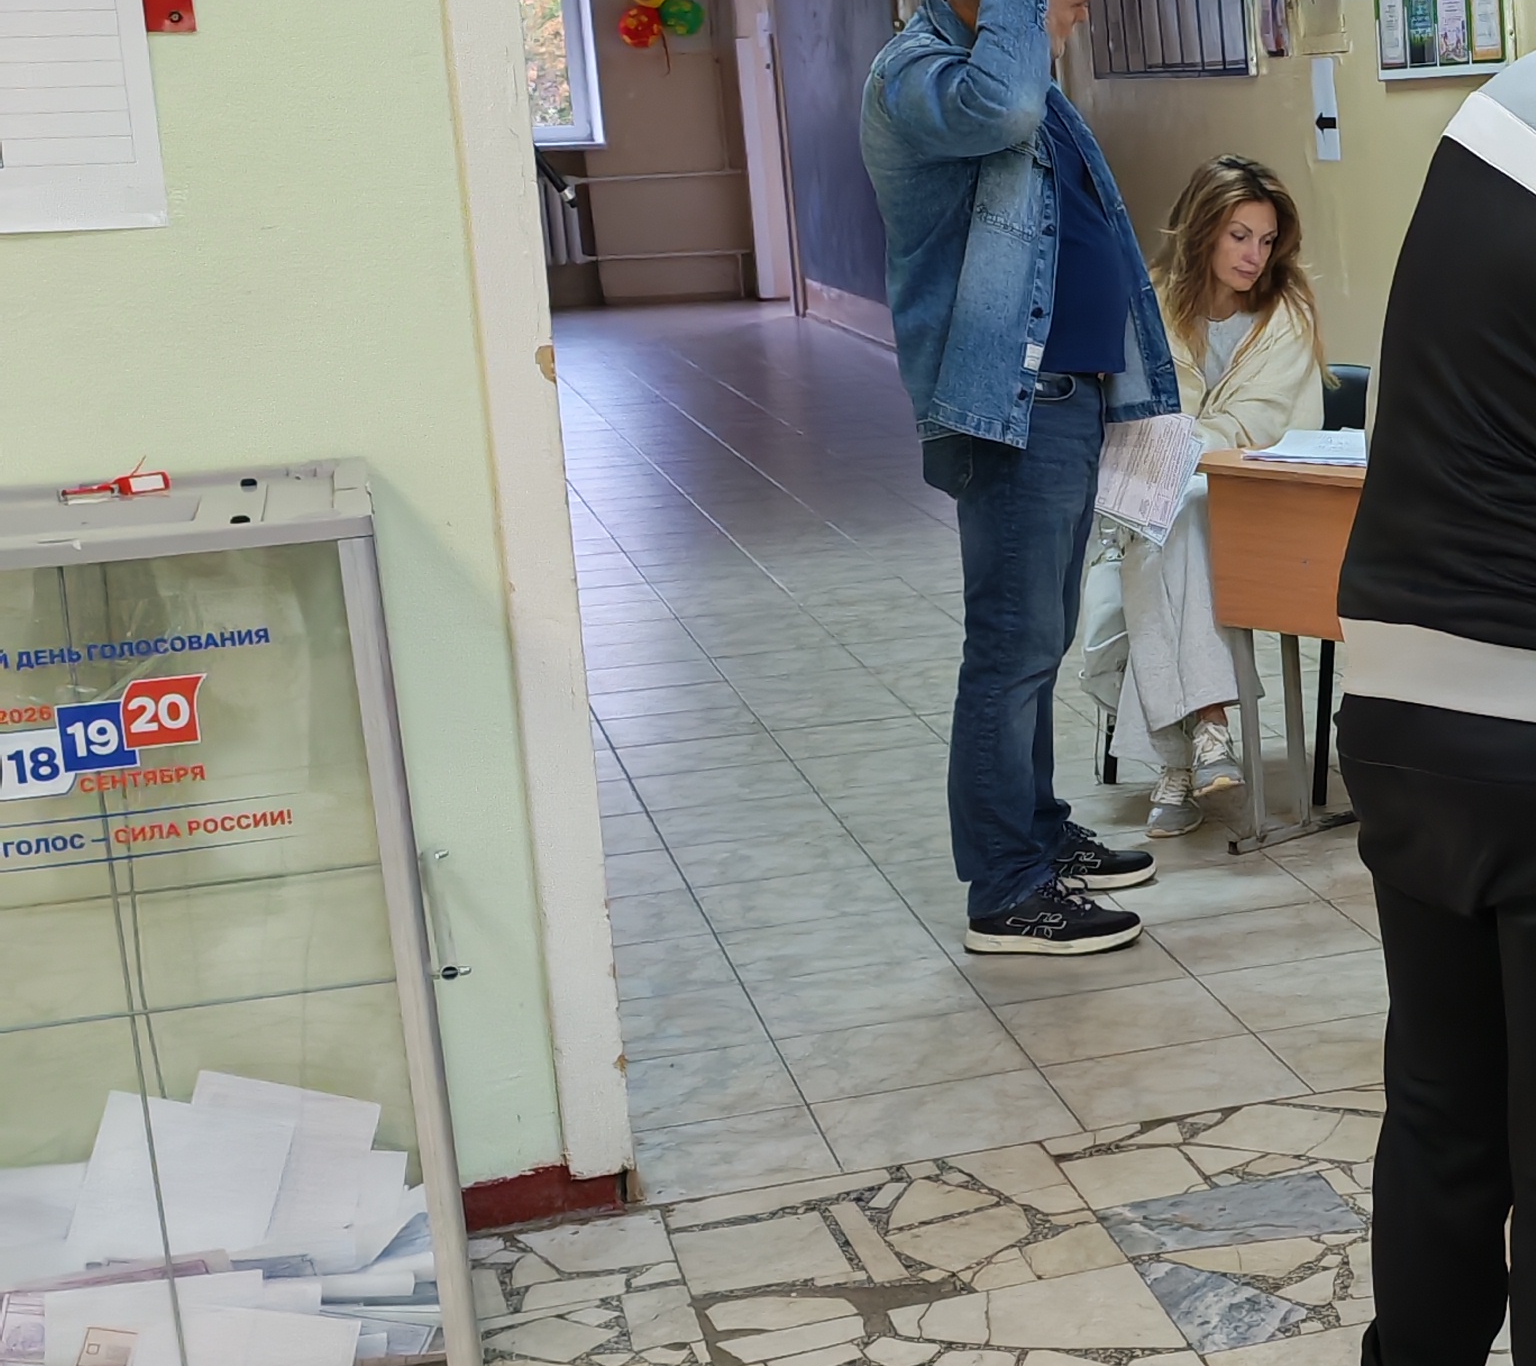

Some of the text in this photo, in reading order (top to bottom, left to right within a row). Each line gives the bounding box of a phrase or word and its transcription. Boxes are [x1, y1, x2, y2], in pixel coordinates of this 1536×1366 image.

[16, 647, 82, 671] ДЕНЬ
[87, 627, 271, 662] ГОЛОСОВАНИЯ
[7, 693, 190, 784] 18 19 20
[79, 763, 207, 793] СЕНТЯБРЯ
[2, 833, 86, 858] ГОЛОС
[114, 821, 181, 844] СИЛА
[187, 808, 293, 836] РОССИИ!
